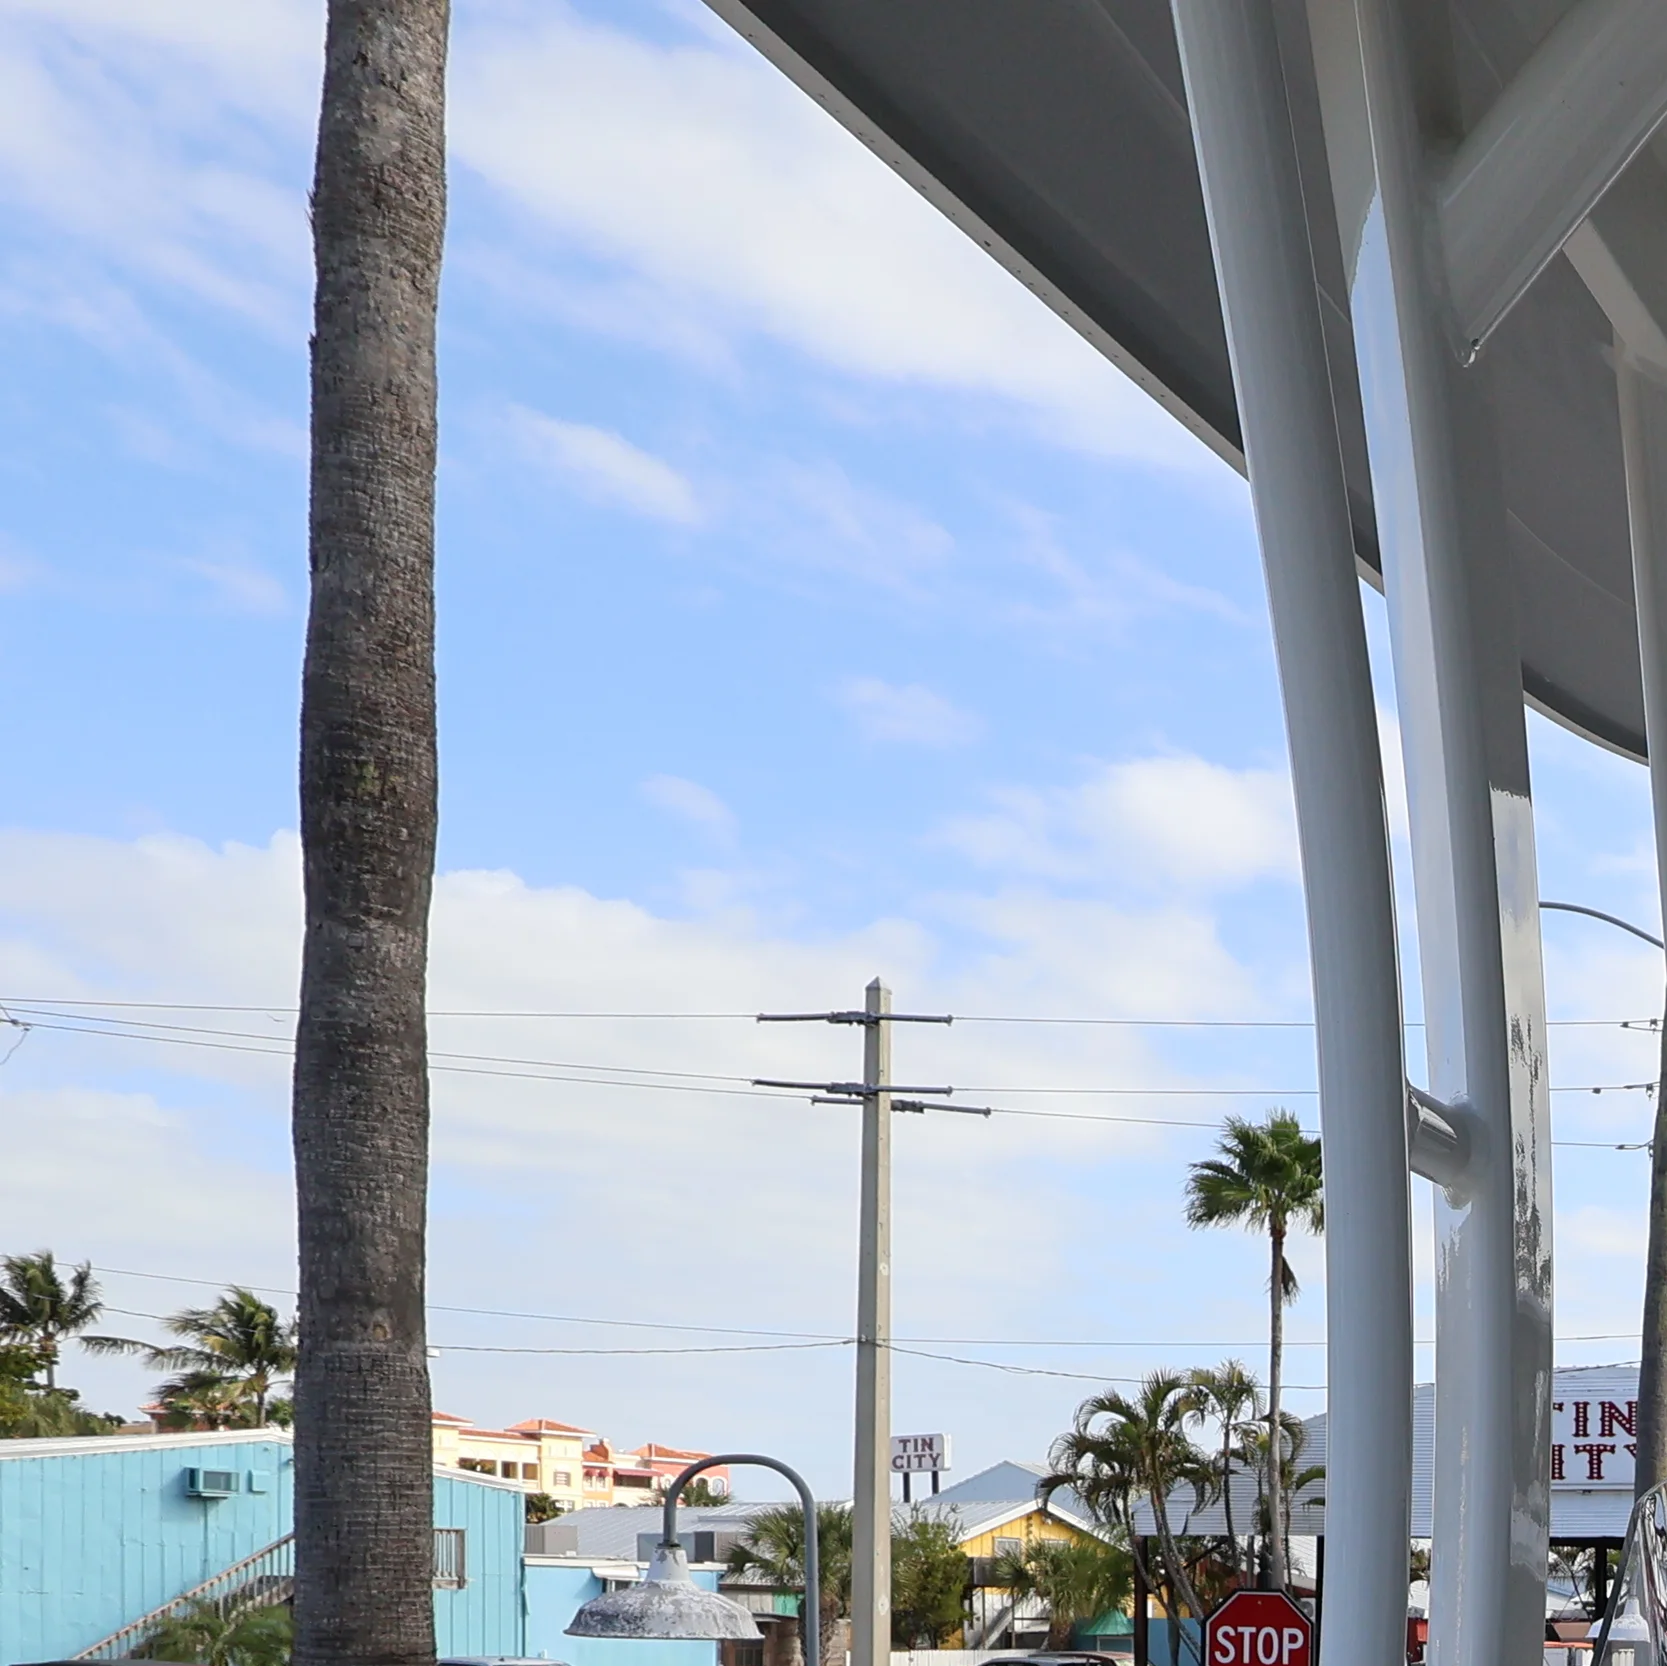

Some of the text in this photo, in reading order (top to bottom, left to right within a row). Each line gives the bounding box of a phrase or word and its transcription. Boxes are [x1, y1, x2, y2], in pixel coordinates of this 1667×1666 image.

[1553, 1401, 1638, 1437] IN
[891, 1452, 941, 1470] CITY
[897, 1437, 934, 1453] TIN
[1552, 1443, 1637, 1480] IT
[1214, 1625, 1304, 1665] STOP
